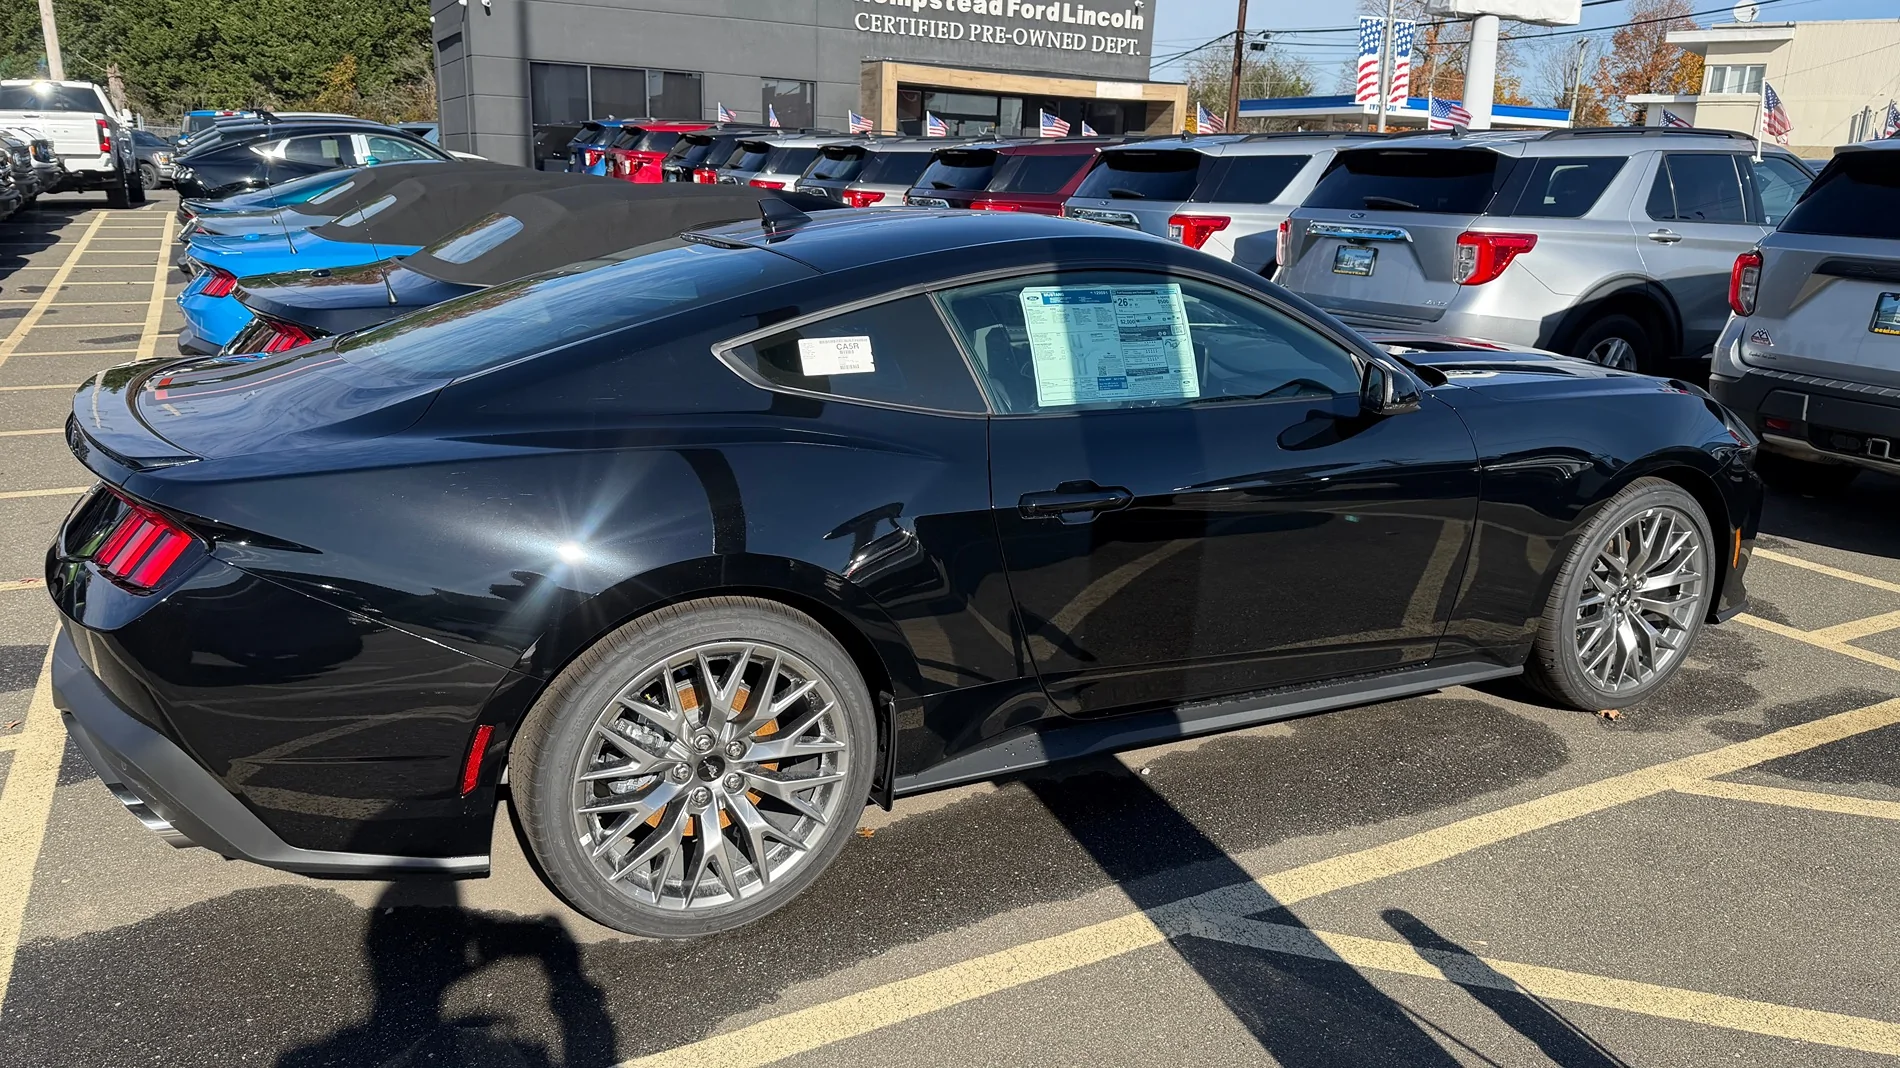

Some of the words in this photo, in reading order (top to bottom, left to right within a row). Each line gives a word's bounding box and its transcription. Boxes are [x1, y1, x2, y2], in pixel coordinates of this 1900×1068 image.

[851, 0, 1003, 16] pstead
[1007, 0, 1060, 22] Ford
[1062, 3, 1144, 31] Lincoln
[855, 12, 964, 40] CERTIFIED
[969, 23, 1087, 51] PRE-OWNED
[1091, 35, 1140, 55] DEPT.
[1117, 297, 1128, 306] 26
